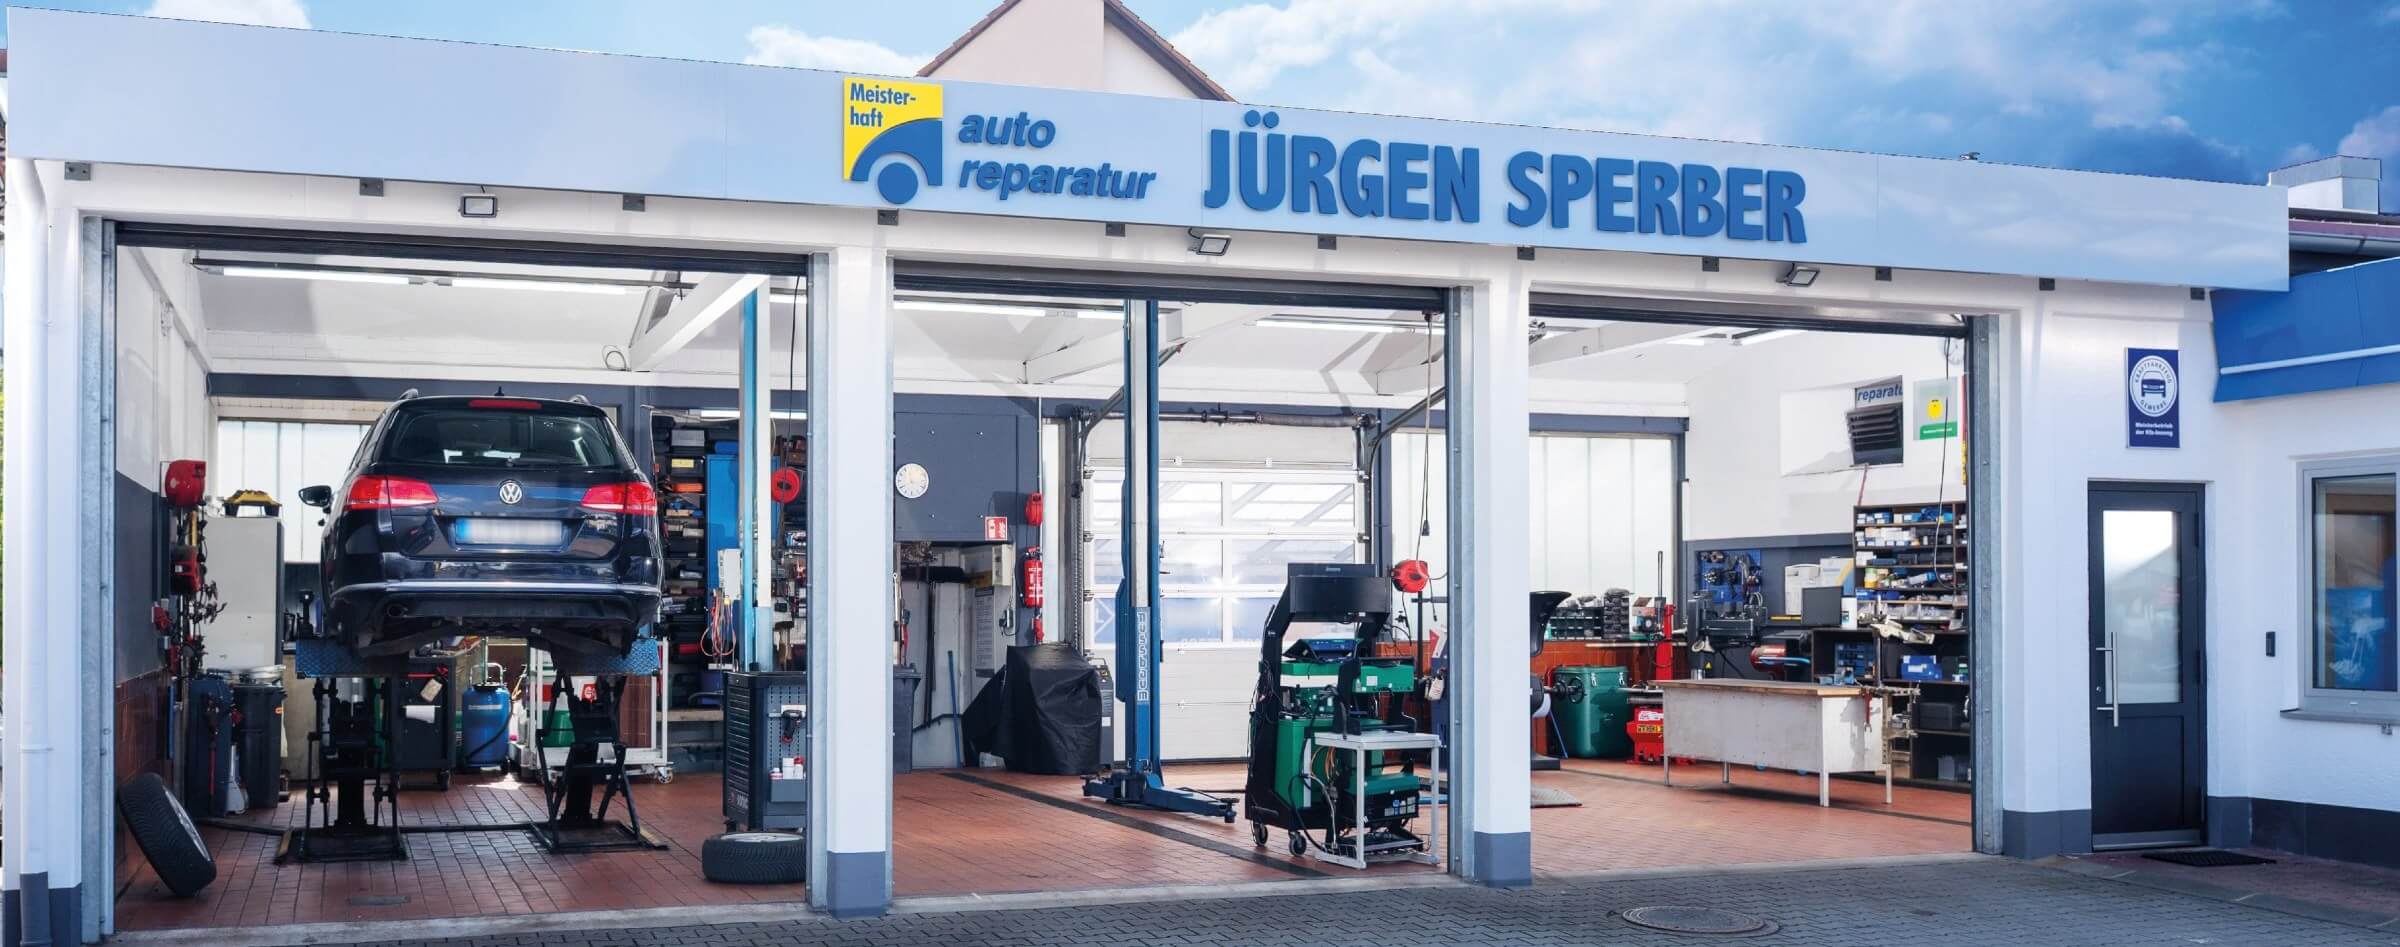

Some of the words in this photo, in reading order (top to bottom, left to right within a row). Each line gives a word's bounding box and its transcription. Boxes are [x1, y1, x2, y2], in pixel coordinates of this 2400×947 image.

[850, 83, 916, 105] Meister-
[850, 106, 883, 127] haft
[958, 111, 1056, 148] auto
[958, 158, 1156, 200] reparatur
[1204, 110, 1480, 223] JÜRGEN
[1508, 152, 1808, 244] SPERBER
